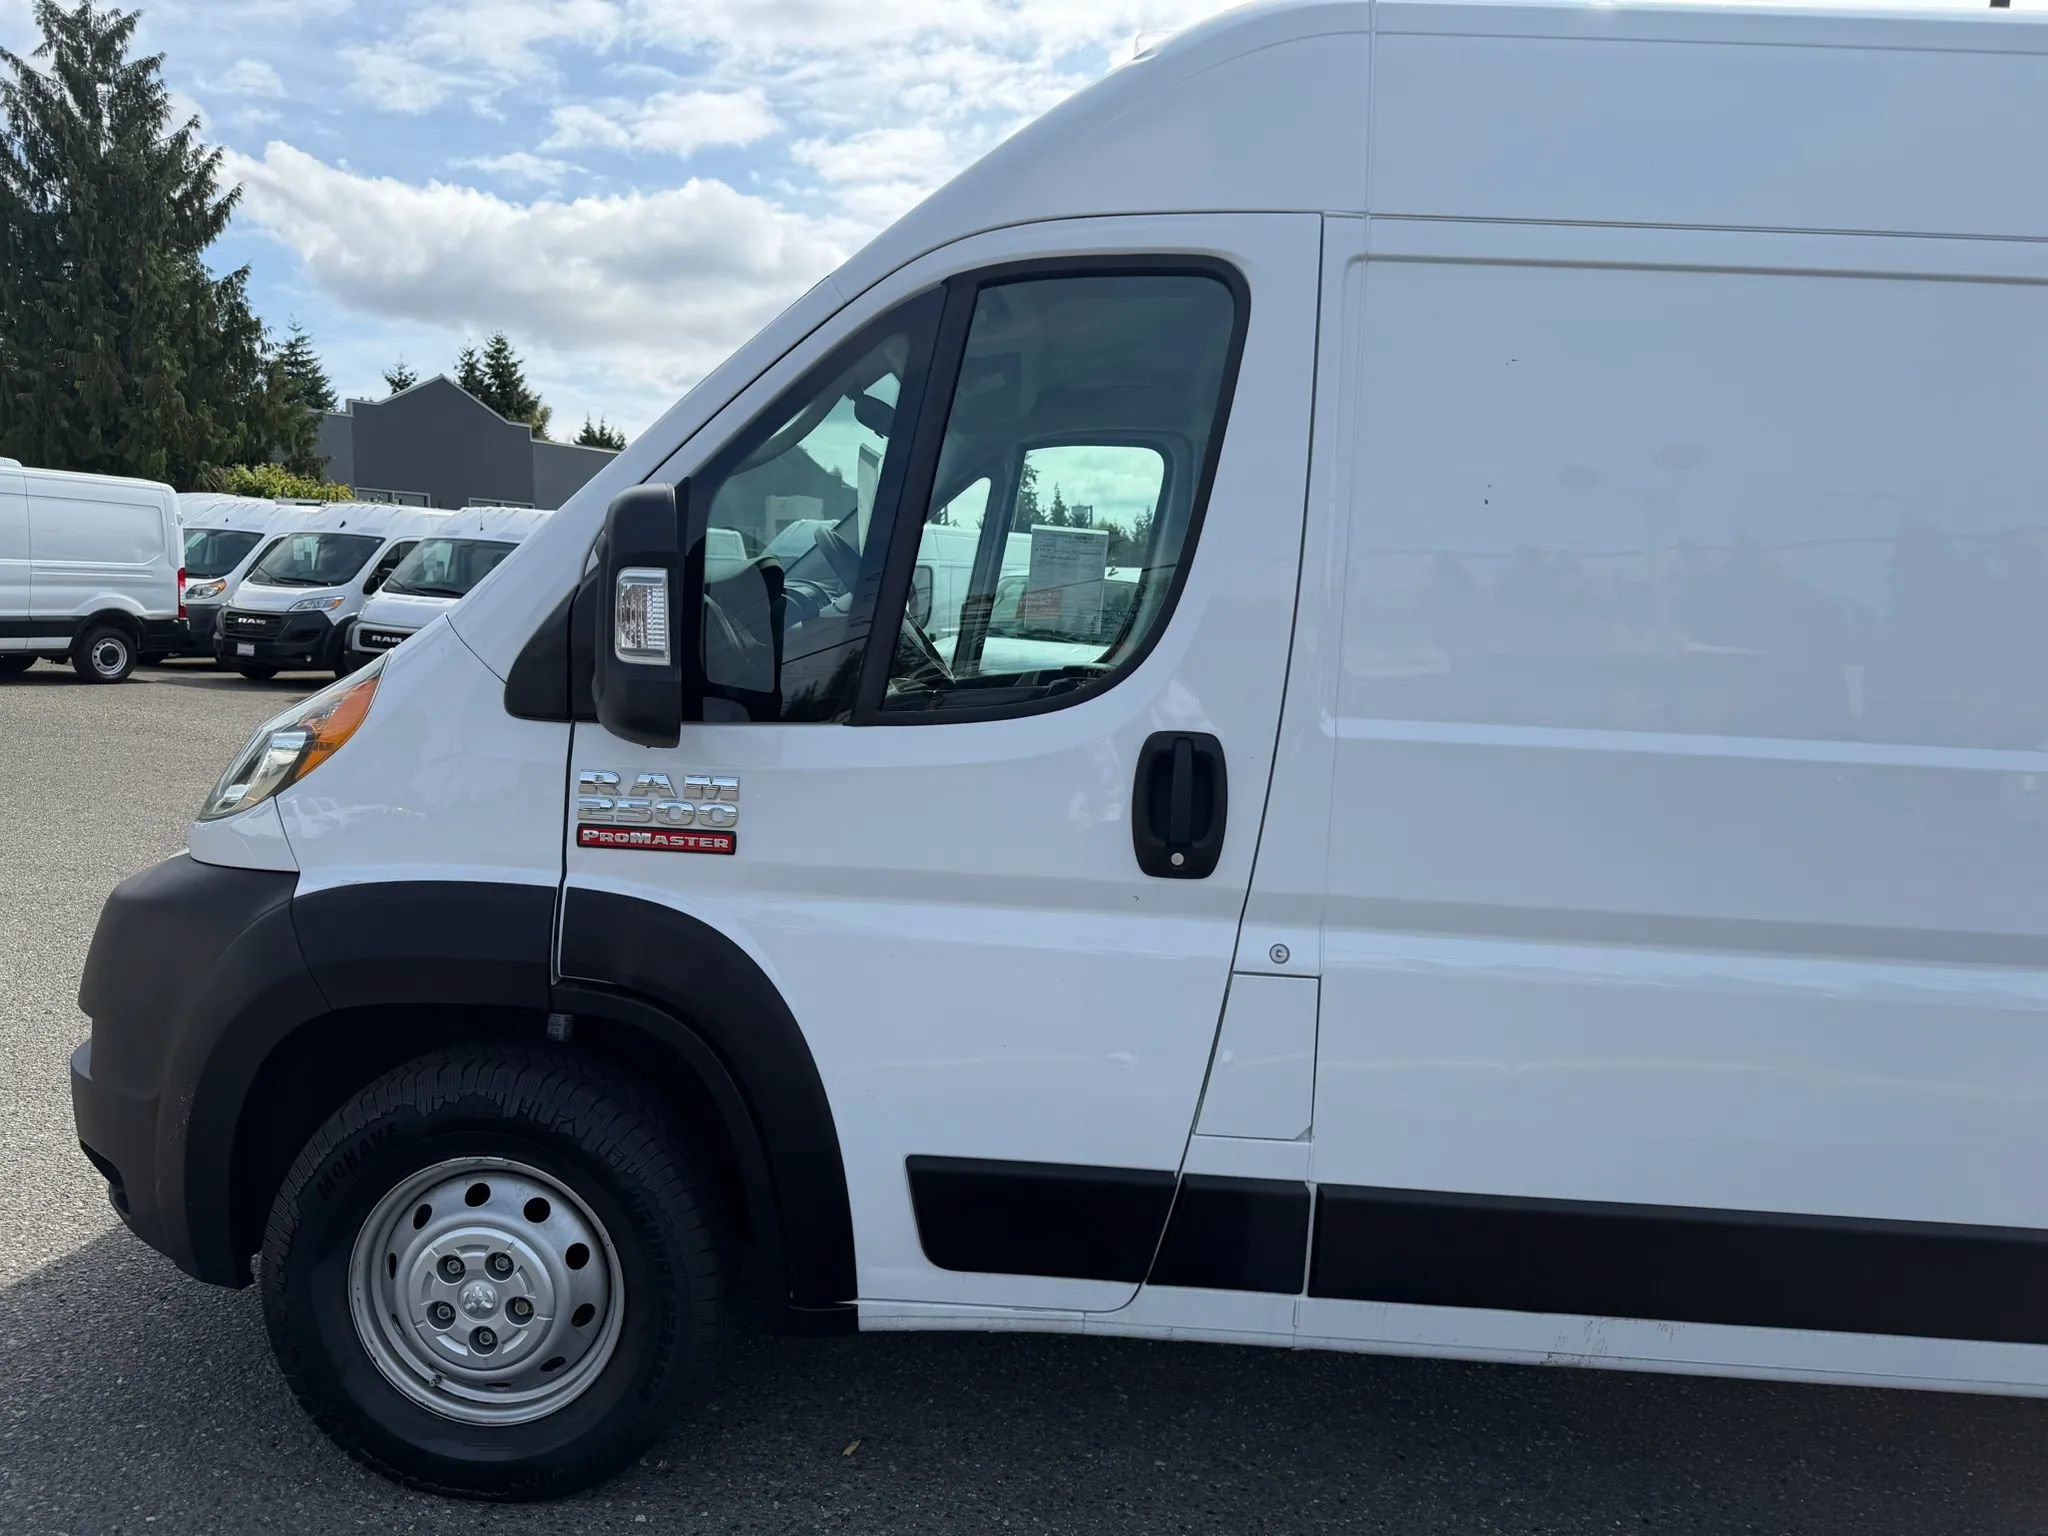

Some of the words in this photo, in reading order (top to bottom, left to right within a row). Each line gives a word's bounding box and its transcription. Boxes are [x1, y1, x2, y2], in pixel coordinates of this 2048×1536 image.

[579, 770, 740, 801] RAM
[577, 797, 738, 827] 2500
[582, 829, 729, 849] PROMASTER
